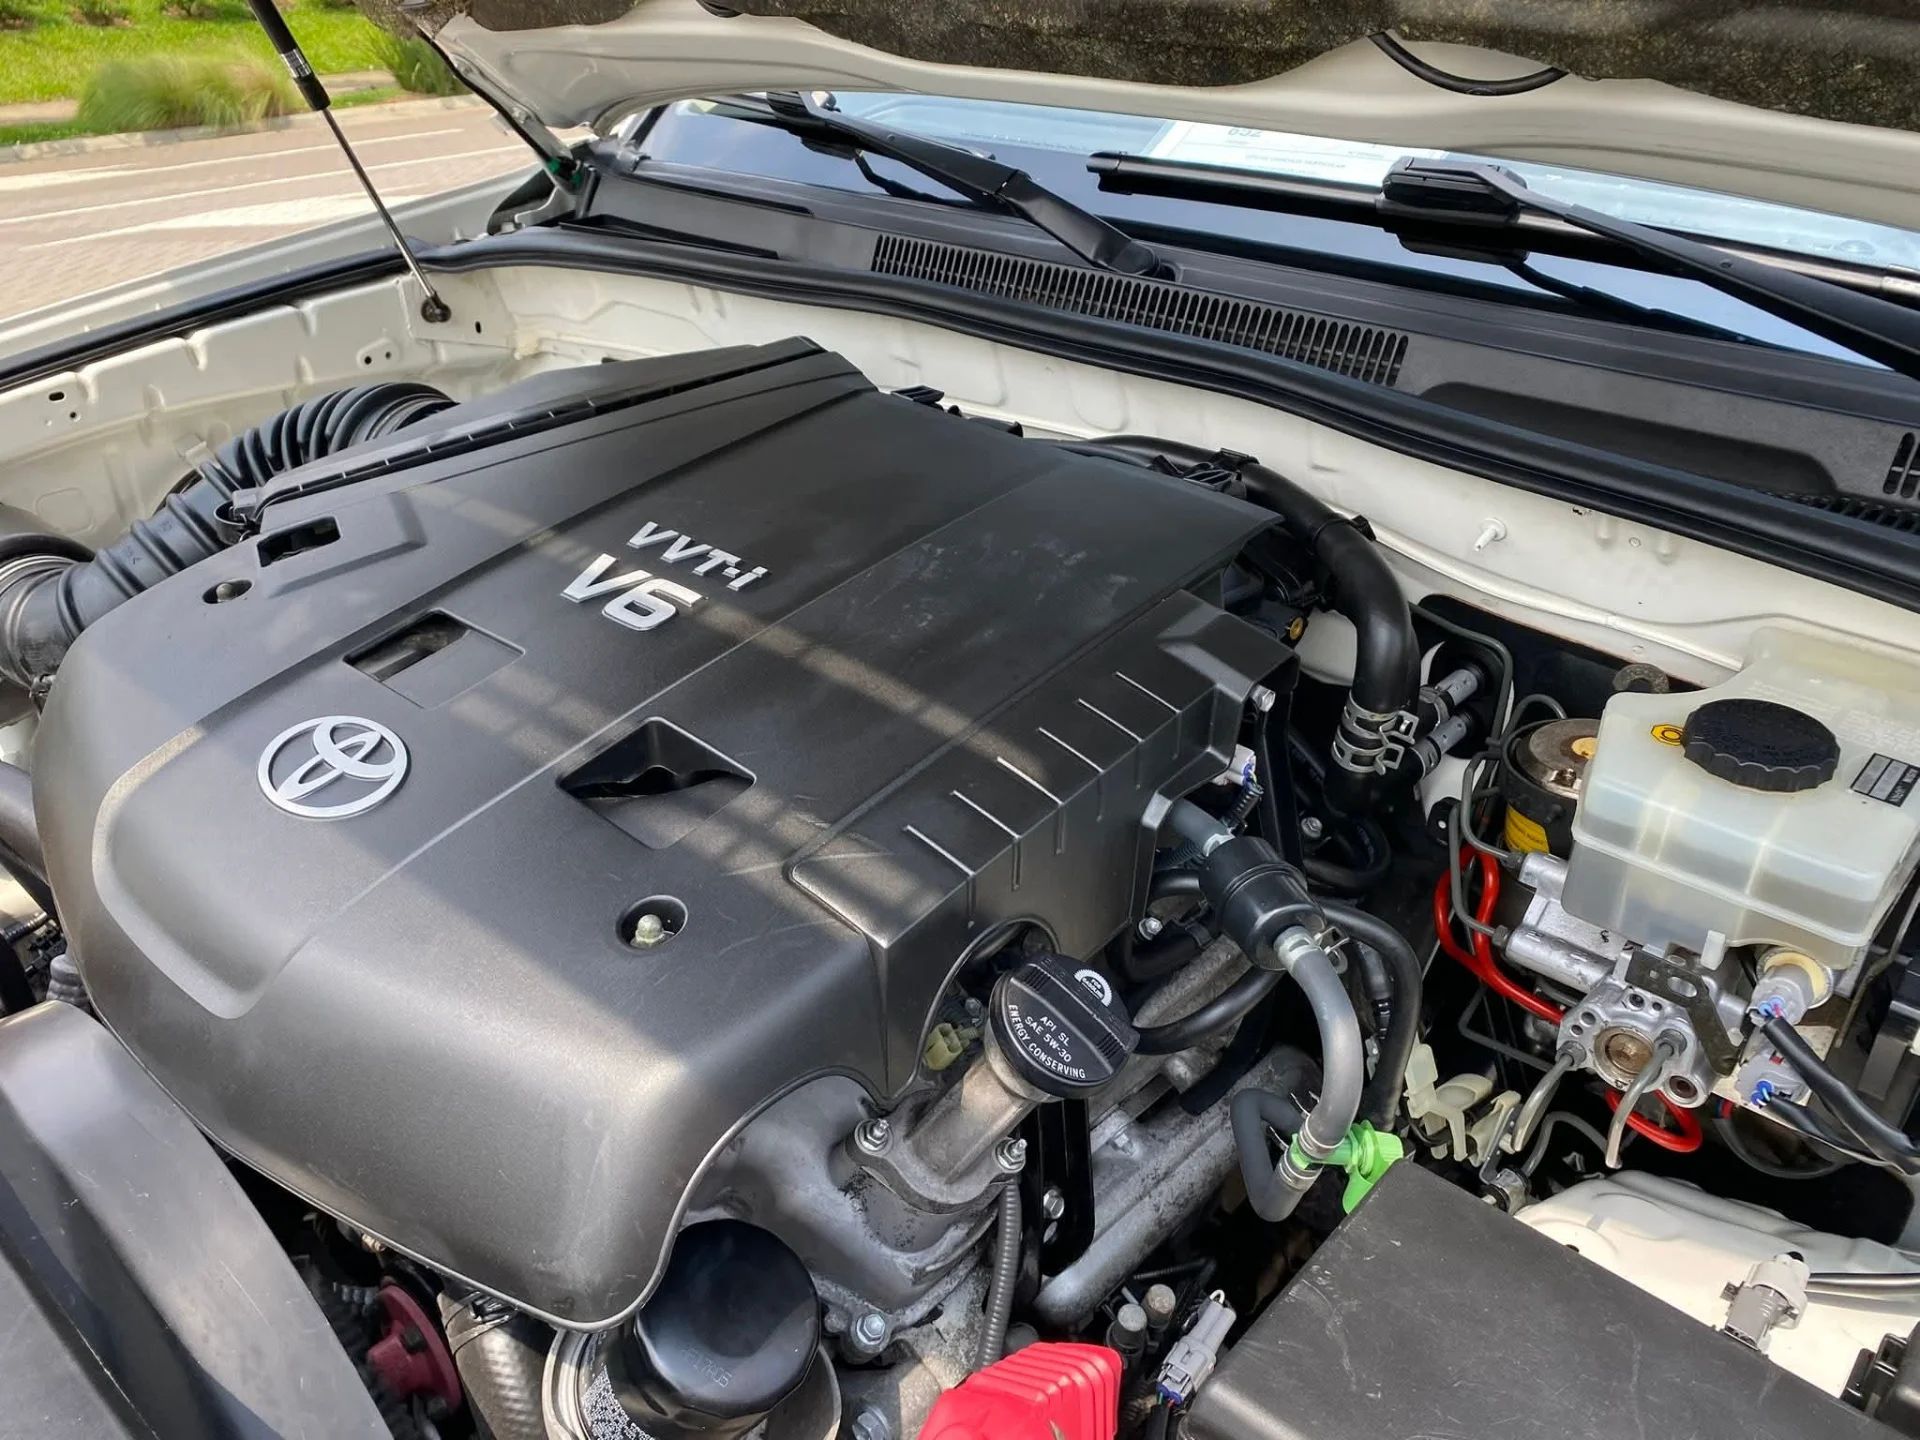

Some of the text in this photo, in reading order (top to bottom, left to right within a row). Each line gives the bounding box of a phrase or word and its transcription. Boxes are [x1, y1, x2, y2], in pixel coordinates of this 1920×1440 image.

[626, 521, 768, 591] VVT-i
[560, 553, 703, 631] V6
[1008, 1004, 1086, 1079] ENERGY CONSERVING
[1025, 1016, 1072, 1062] SAE 5W-30
[1040, 1016, 1070, 1047] API SL
